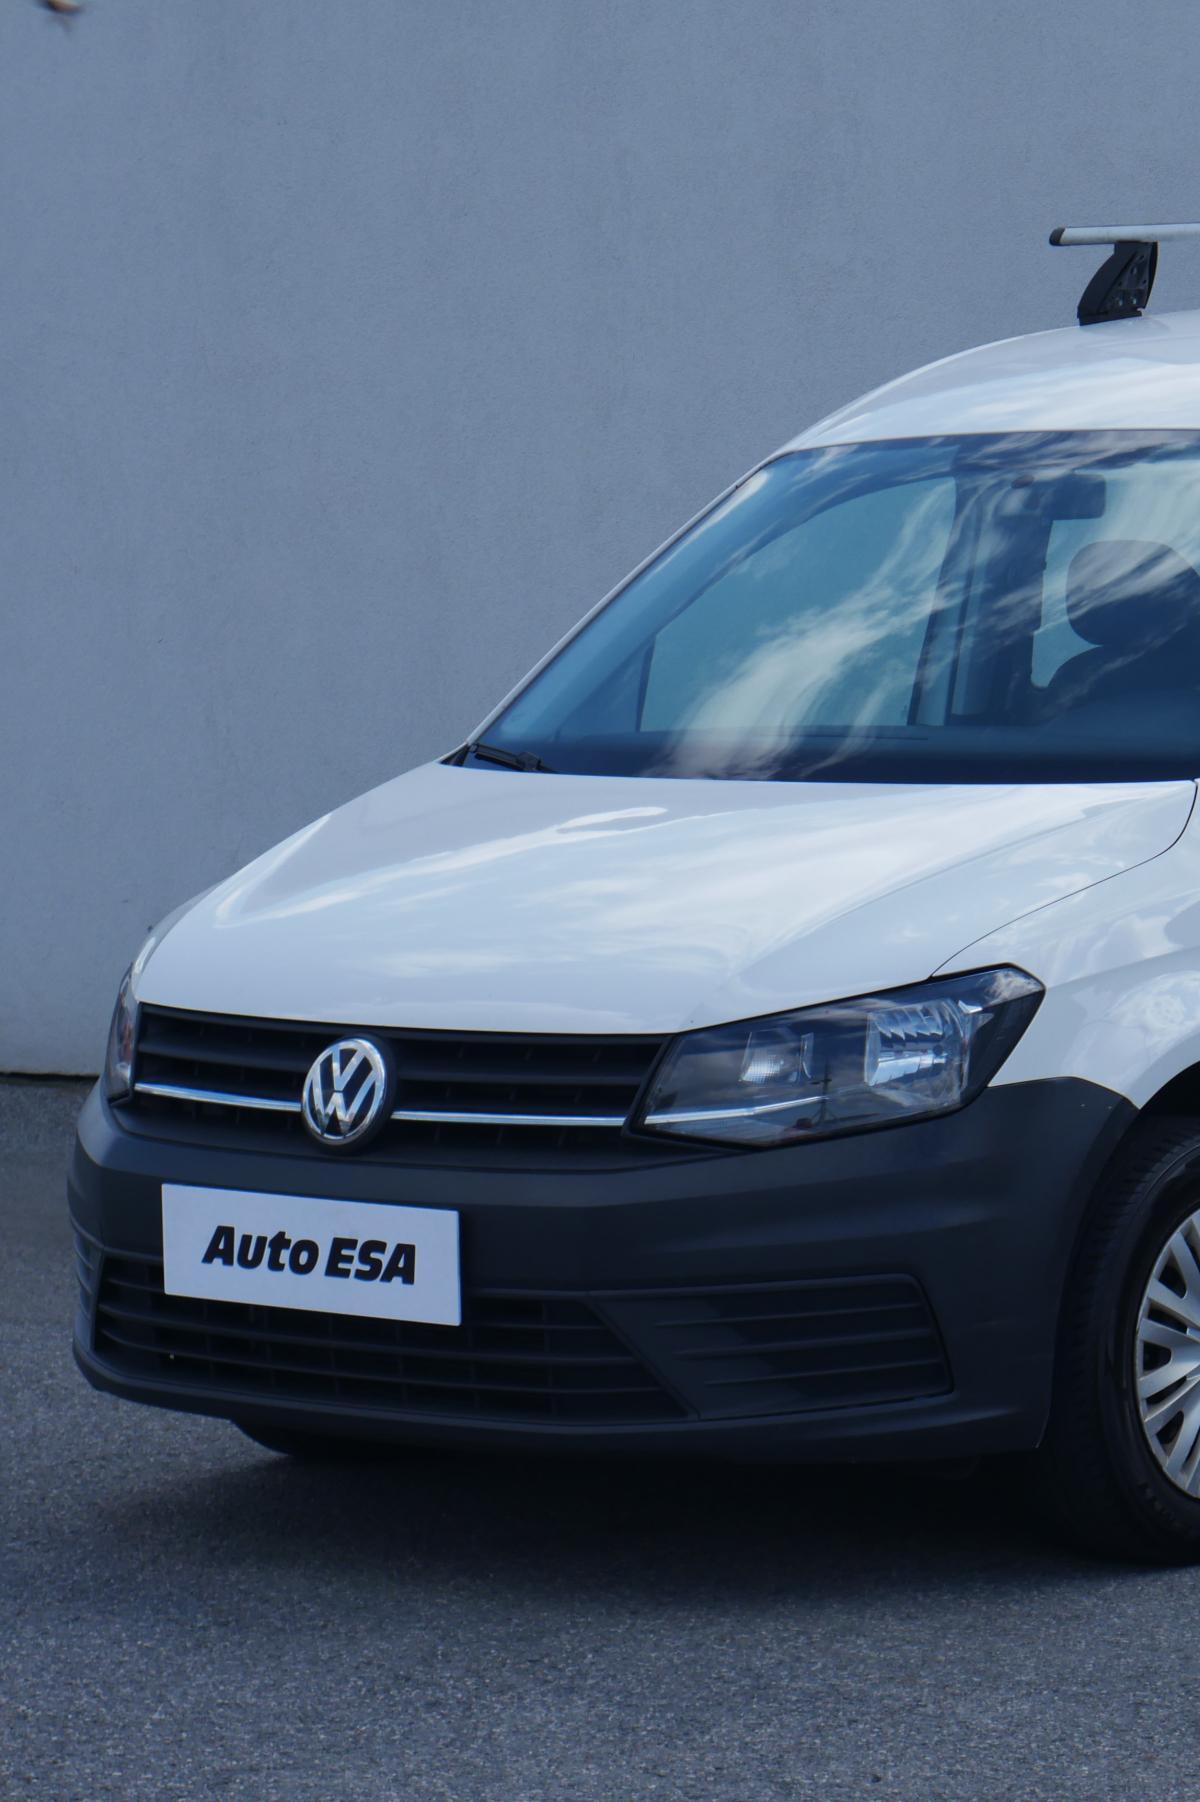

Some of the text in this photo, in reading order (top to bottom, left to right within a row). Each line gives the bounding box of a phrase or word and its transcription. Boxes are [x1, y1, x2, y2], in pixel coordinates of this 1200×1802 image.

[303, 1038, 387, 1142] VW
[202, 1225, 416, 1285] Auto ESA
